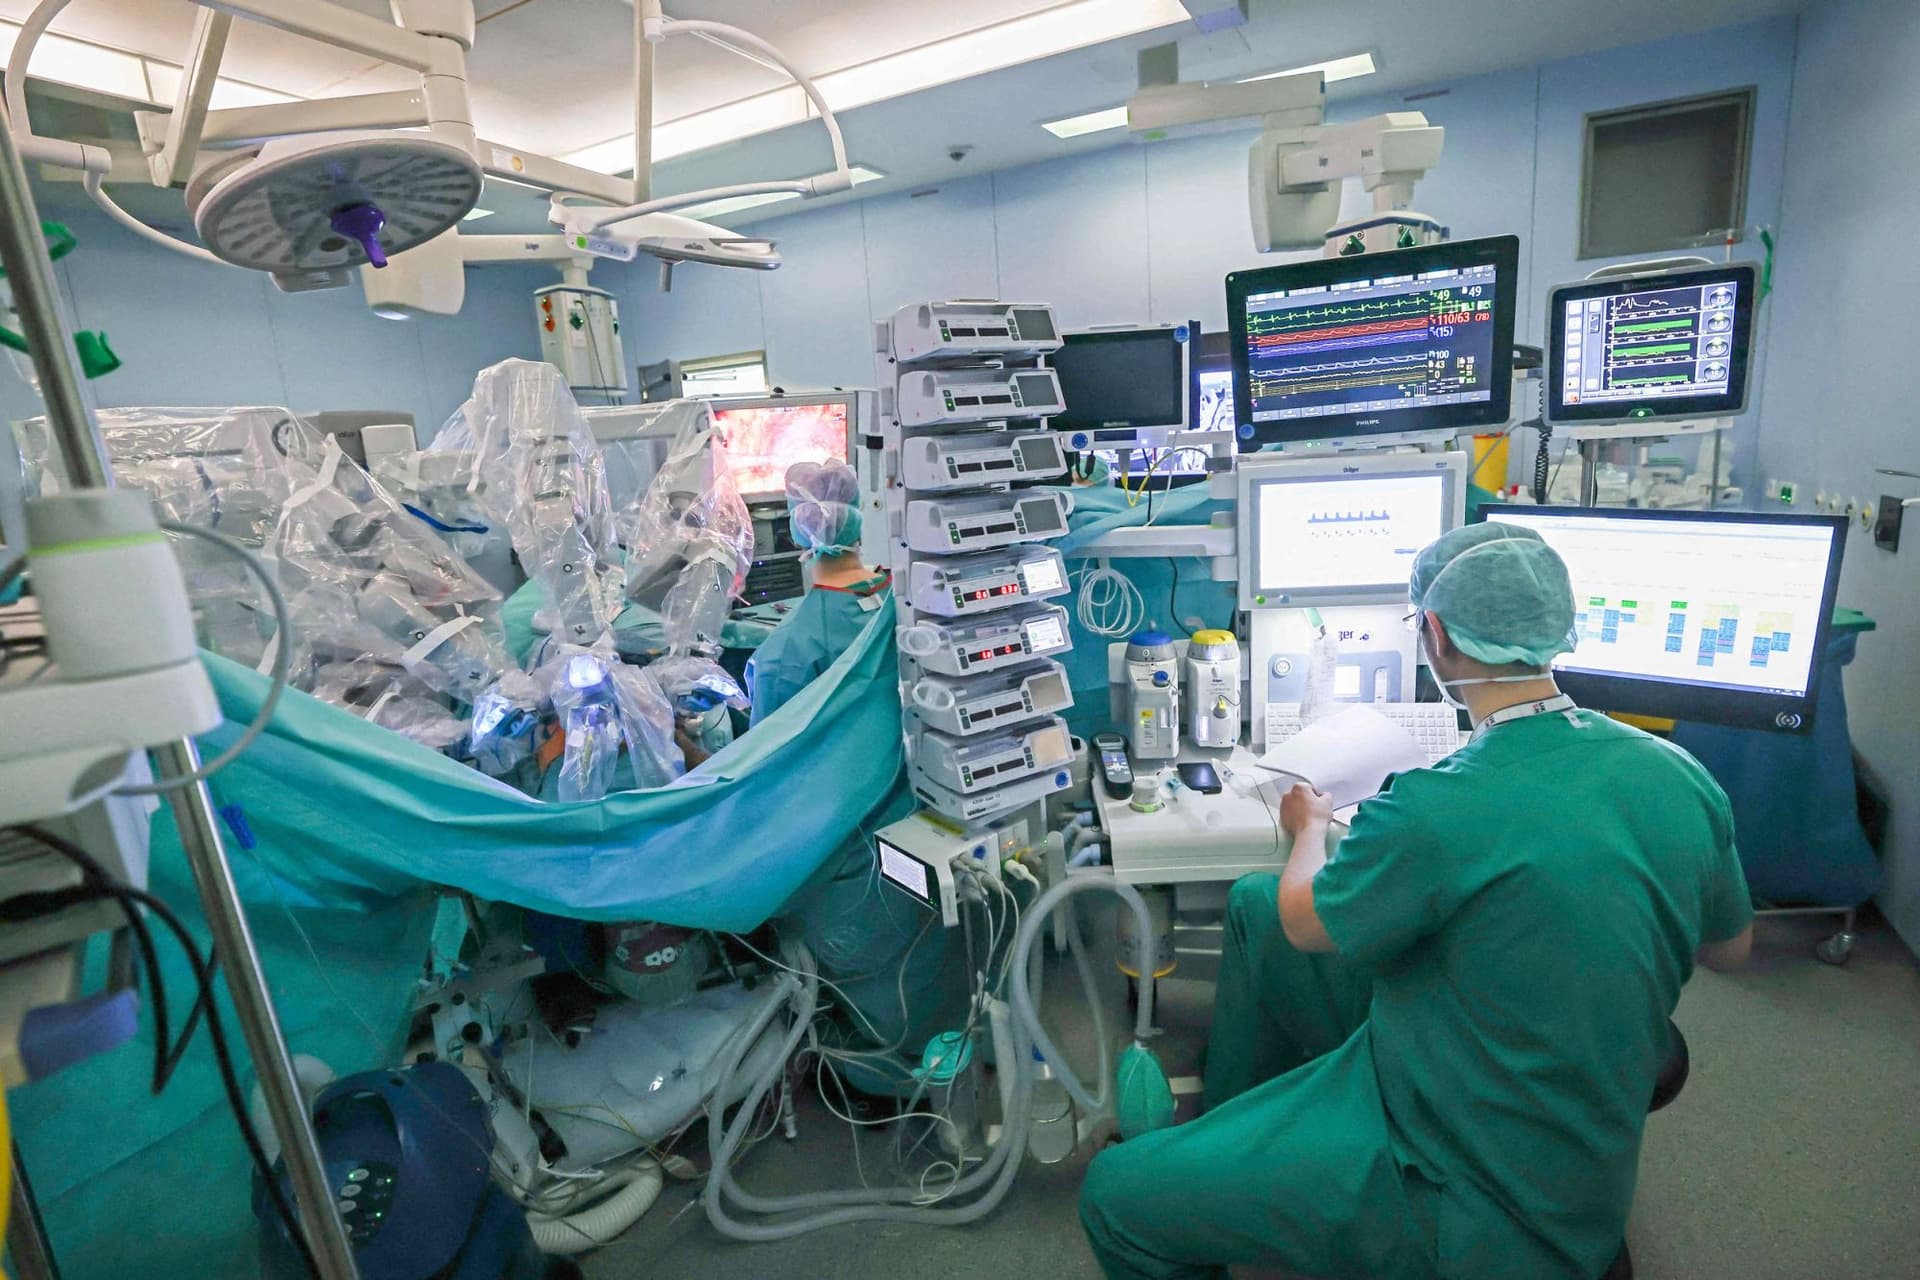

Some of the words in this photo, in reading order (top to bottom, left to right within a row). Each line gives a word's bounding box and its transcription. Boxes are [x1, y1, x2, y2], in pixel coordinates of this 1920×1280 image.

[1437, 290, 1450, 301] 49
[1468, 285, 1482, 297] 49
[1437, 312, 1470, 325] 110/63
[1436, 350, 1449, 360] 100
